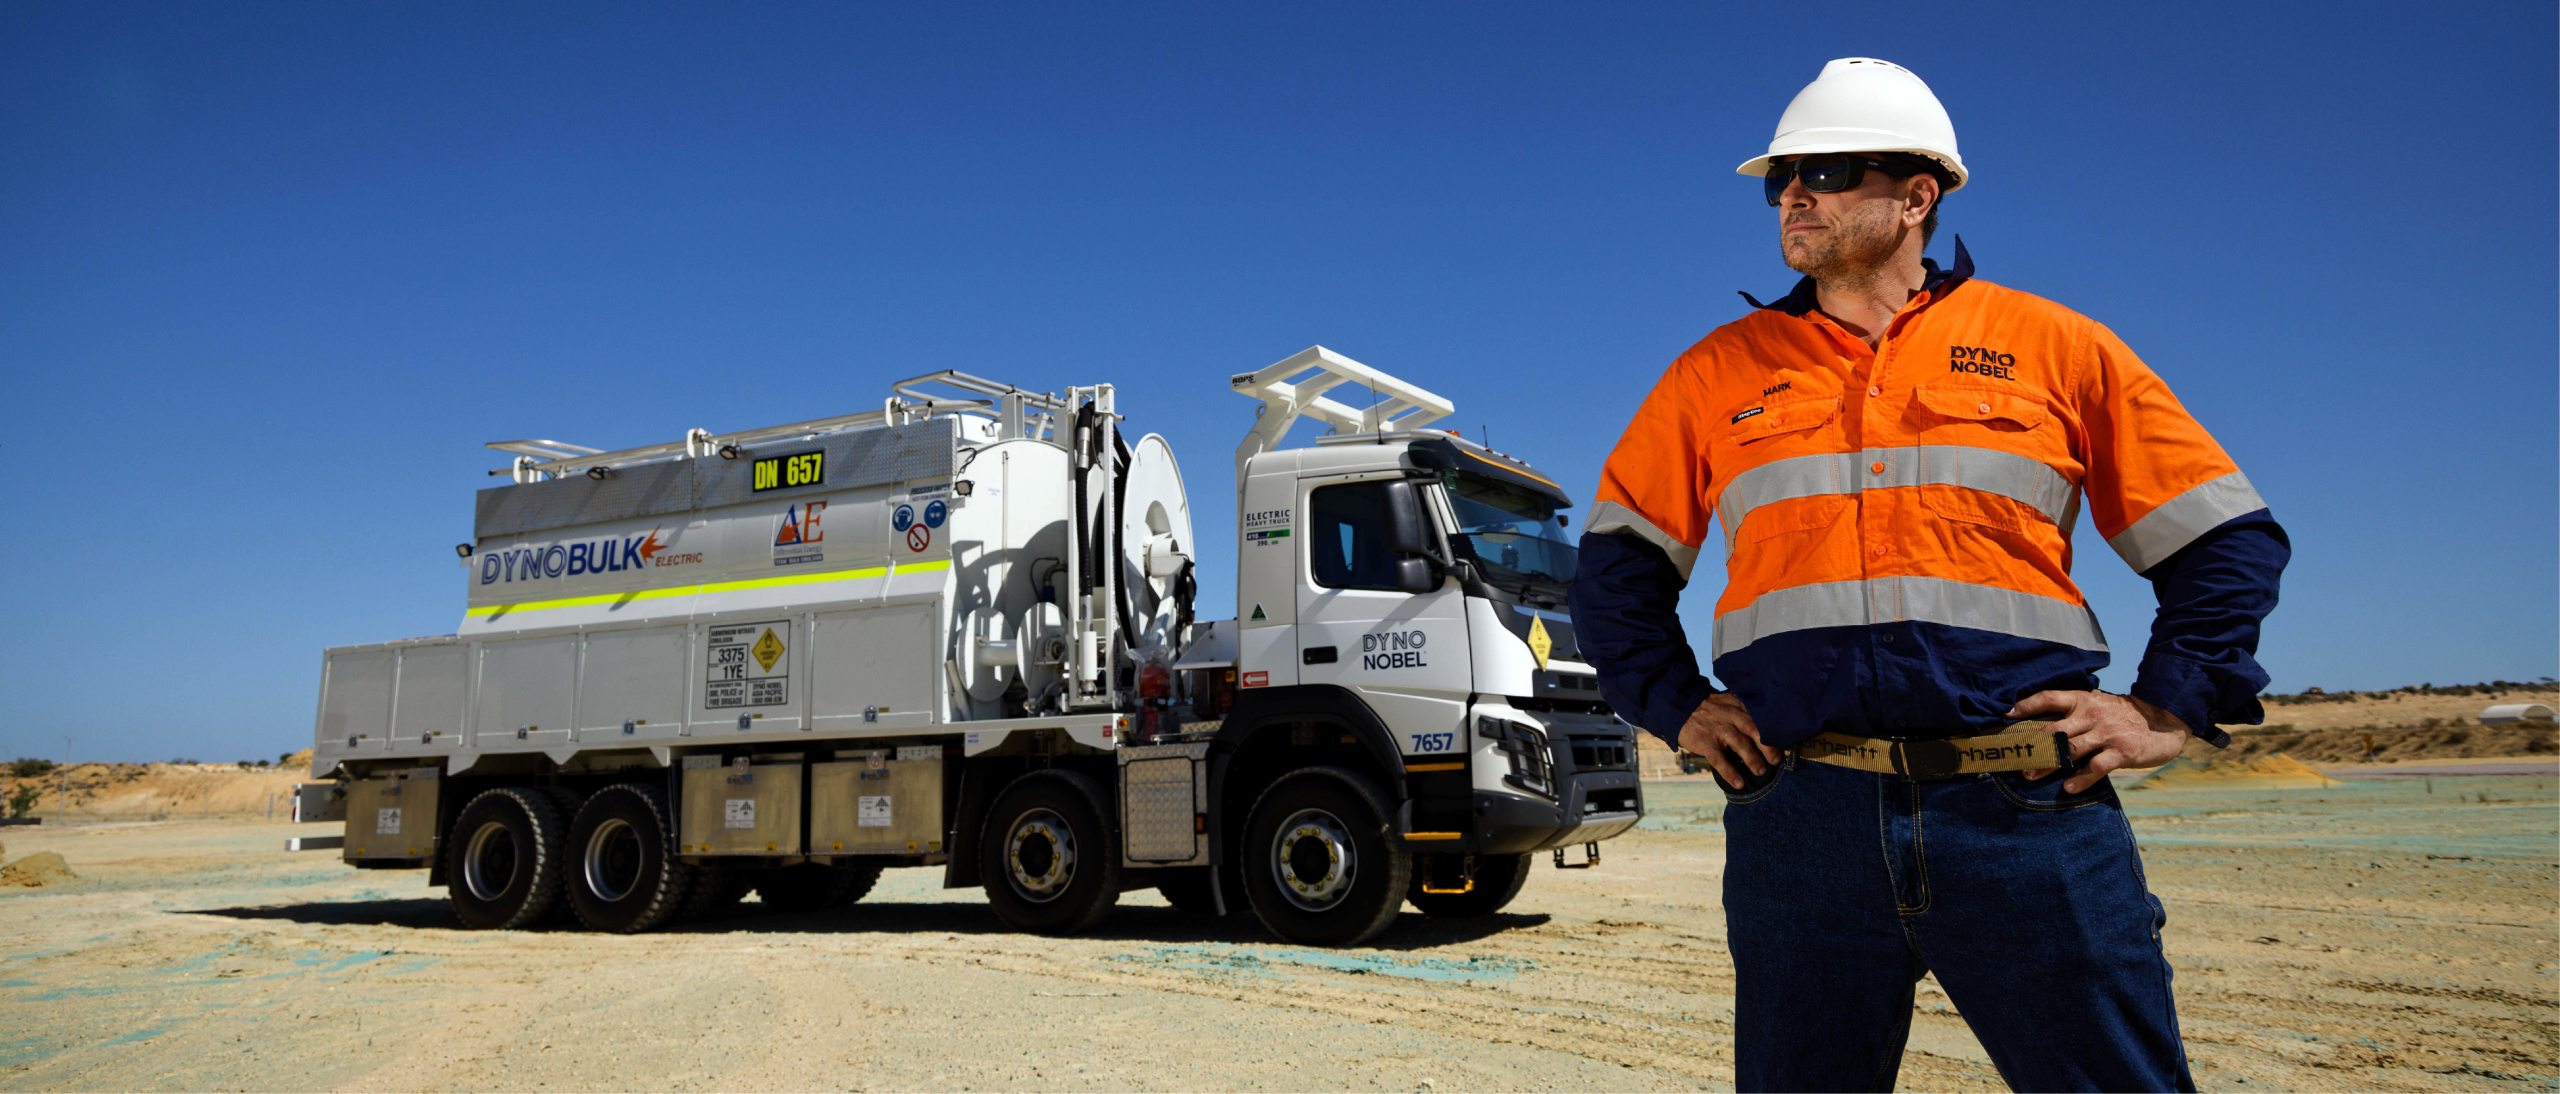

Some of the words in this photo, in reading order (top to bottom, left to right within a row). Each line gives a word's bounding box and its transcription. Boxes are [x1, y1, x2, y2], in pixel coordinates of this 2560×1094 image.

[1950, 346, 2015, 367] DYNO
[1950, 360, 2015, 381] NOBEL
[1763, 381, 1792, 397] MARK
[754, 459, 779, 490] DN
[786, 453, 822, 486] 657
[1246, 509, 1290, 522] ELECTRIC
[1269, 517, 1290, 525] TRUCK
[481, 536, 645, 585] DYNOBULK
[655, 552, 703, 567] ELECTRIC
[1362, 630, 1427, 652] DYNO
[718, 647, 745, 663] 3375
[1363, 651, 1427, 671] NOBEL
[723, 664, 743, 679] 1YE
[1411, 732, 1454, 752] 7657
[1801, 737, 1878, 759] arhartt
[1958, 743, 2035, 762] rhartt
